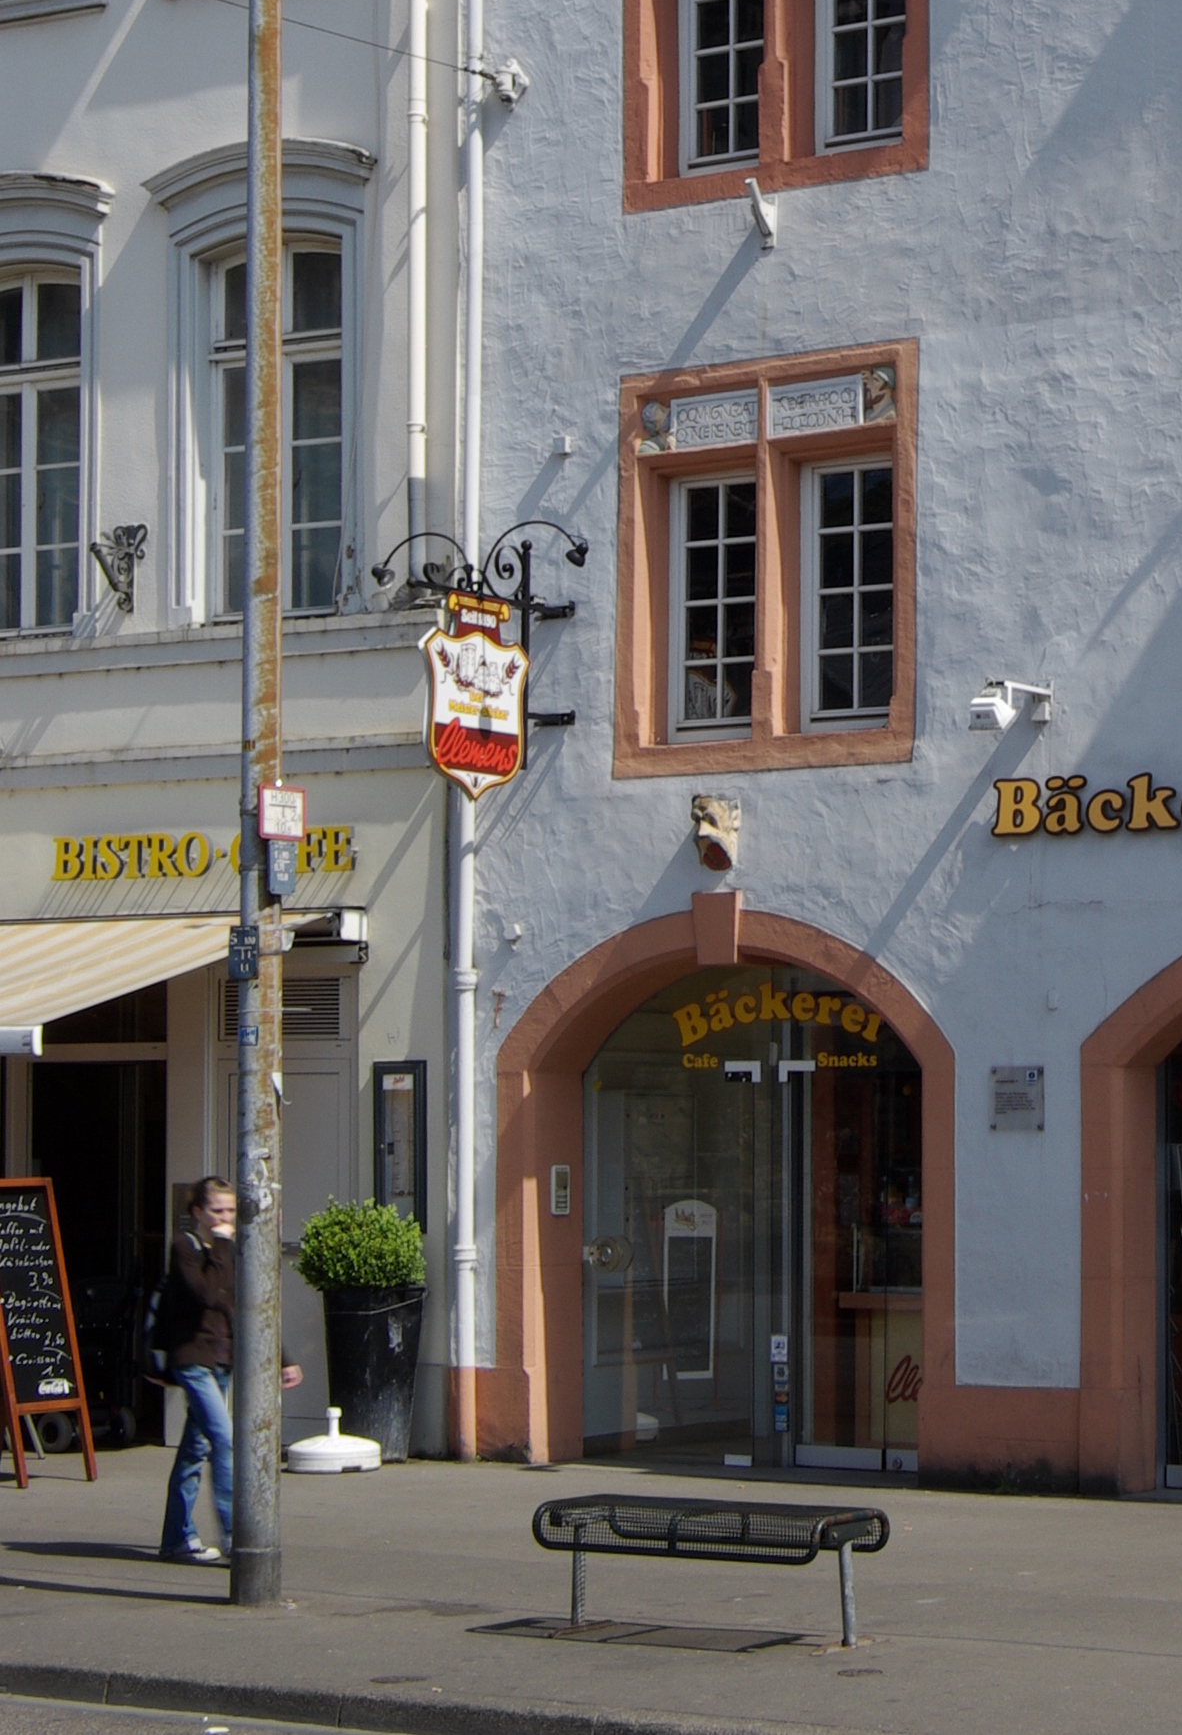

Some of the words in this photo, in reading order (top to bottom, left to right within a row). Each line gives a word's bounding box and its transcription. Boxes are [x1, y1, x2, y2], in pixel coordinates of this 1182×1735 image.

[438, 717, 518, 772] Clemens
[52, 831, 211, 881] BISTRO
[673, 981, 883, 1048] Bäckerei
[682, 1053, 719, 1069] Cafe
[817, 1051, 878, 1069] Snacks
